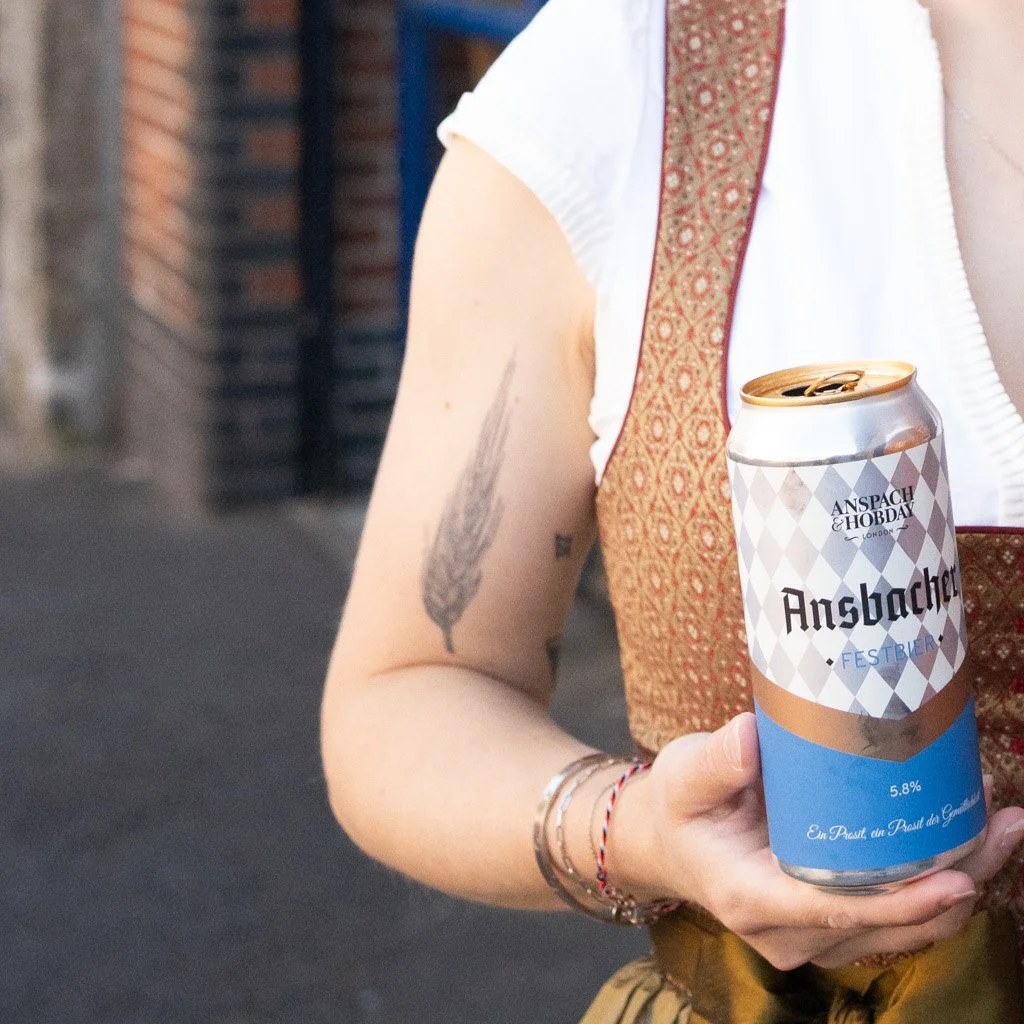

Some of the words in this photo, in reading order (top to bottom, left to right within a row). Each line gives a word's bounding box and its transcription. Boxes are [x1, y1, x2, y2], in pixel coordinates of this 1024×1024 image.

[831, 485, 914, 517] ANSPACH
[862, 528, 894, 541] LONDON
[781, 564, 958, 636] Ansbacher
[841, 634, 934, 670] FESTBIER
[890, 780, 922, 797] 5.8%
[807, 824, 827, 841] Ein
[871, 827, 885, 839] ein
[888, 817, 924, 837] Prosit
[926, 813, 941, 828] der
